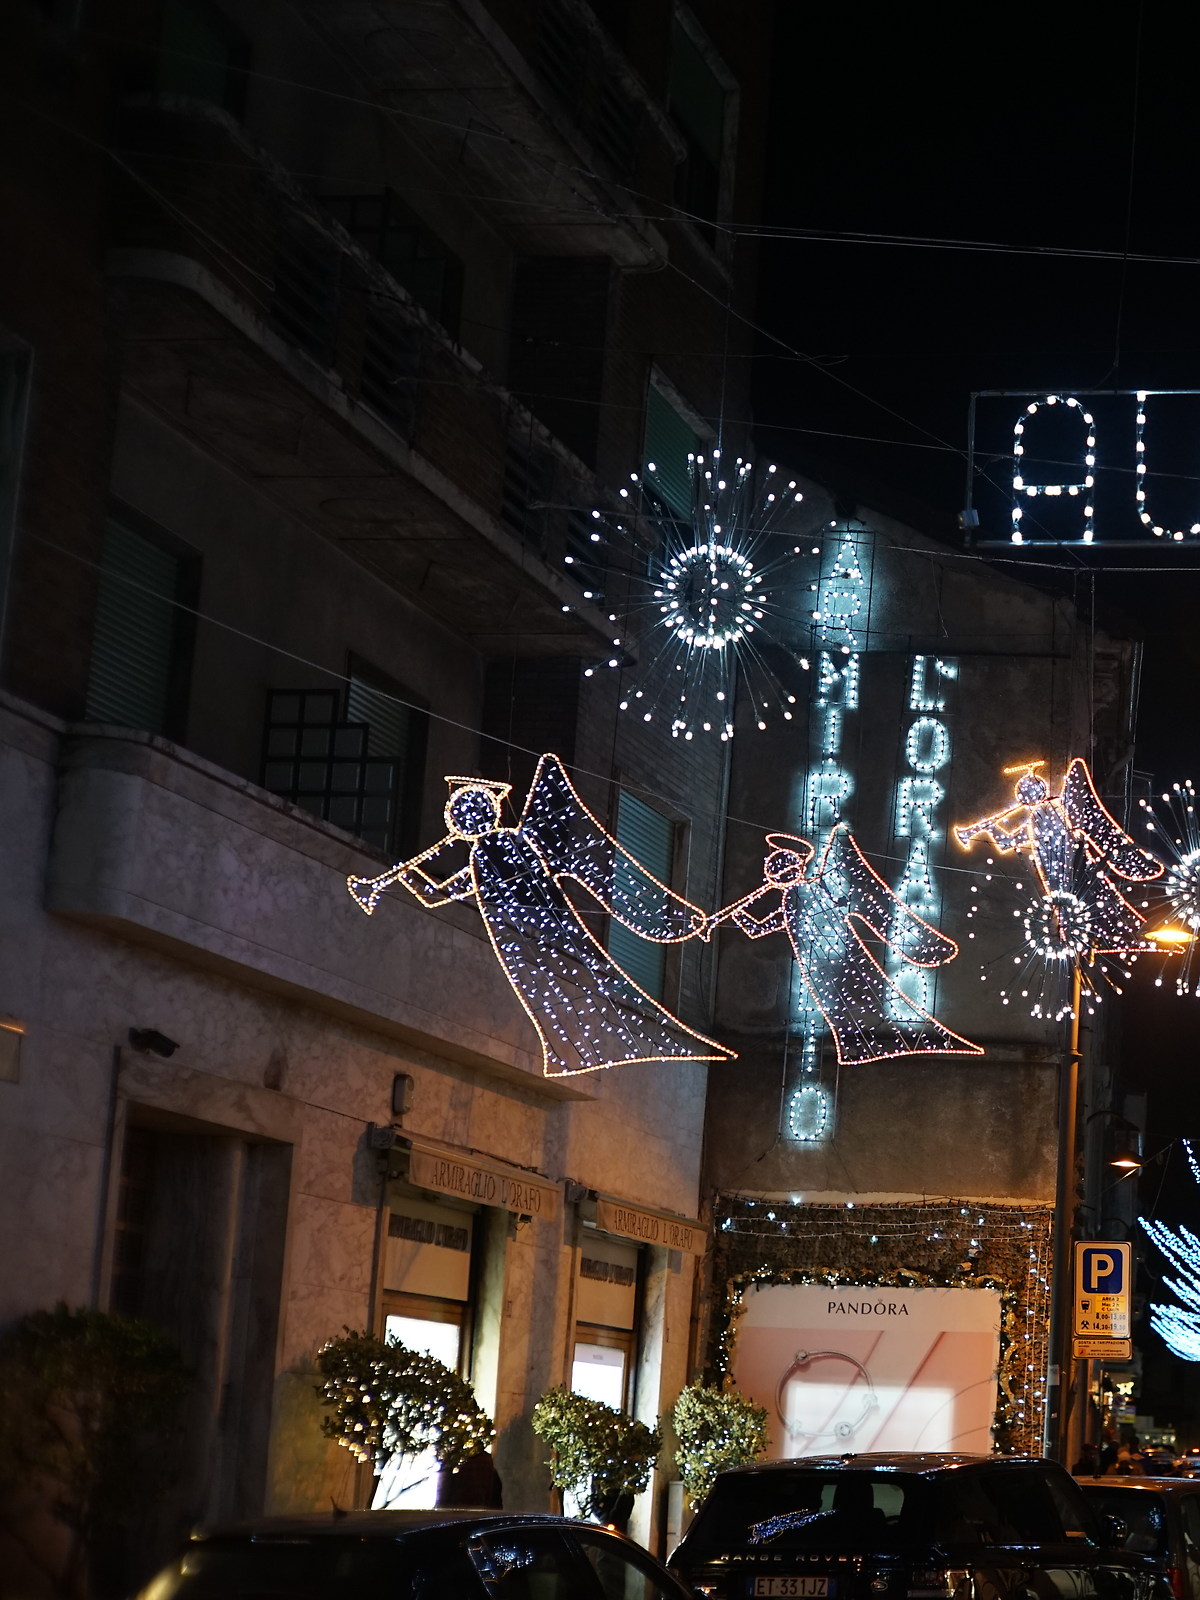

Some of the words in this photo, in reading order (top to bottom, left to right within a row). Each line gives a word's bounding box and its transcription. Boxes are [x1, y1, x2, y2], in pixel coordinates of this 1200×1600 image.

[431, 1161, 496, 1200] ARMIRAGLIO
[501, 1179, 541, 1212] L'ORAFO
[614, 1209, 659, 1240] ARMIRAGLIO
[1090, 1253, 1115, 1289] P
[827, 1300, 909, 1316] PANDORA
[720, 1553, 784, 1562] RANGE
[795, 1554, 864, 1563] ROVER
